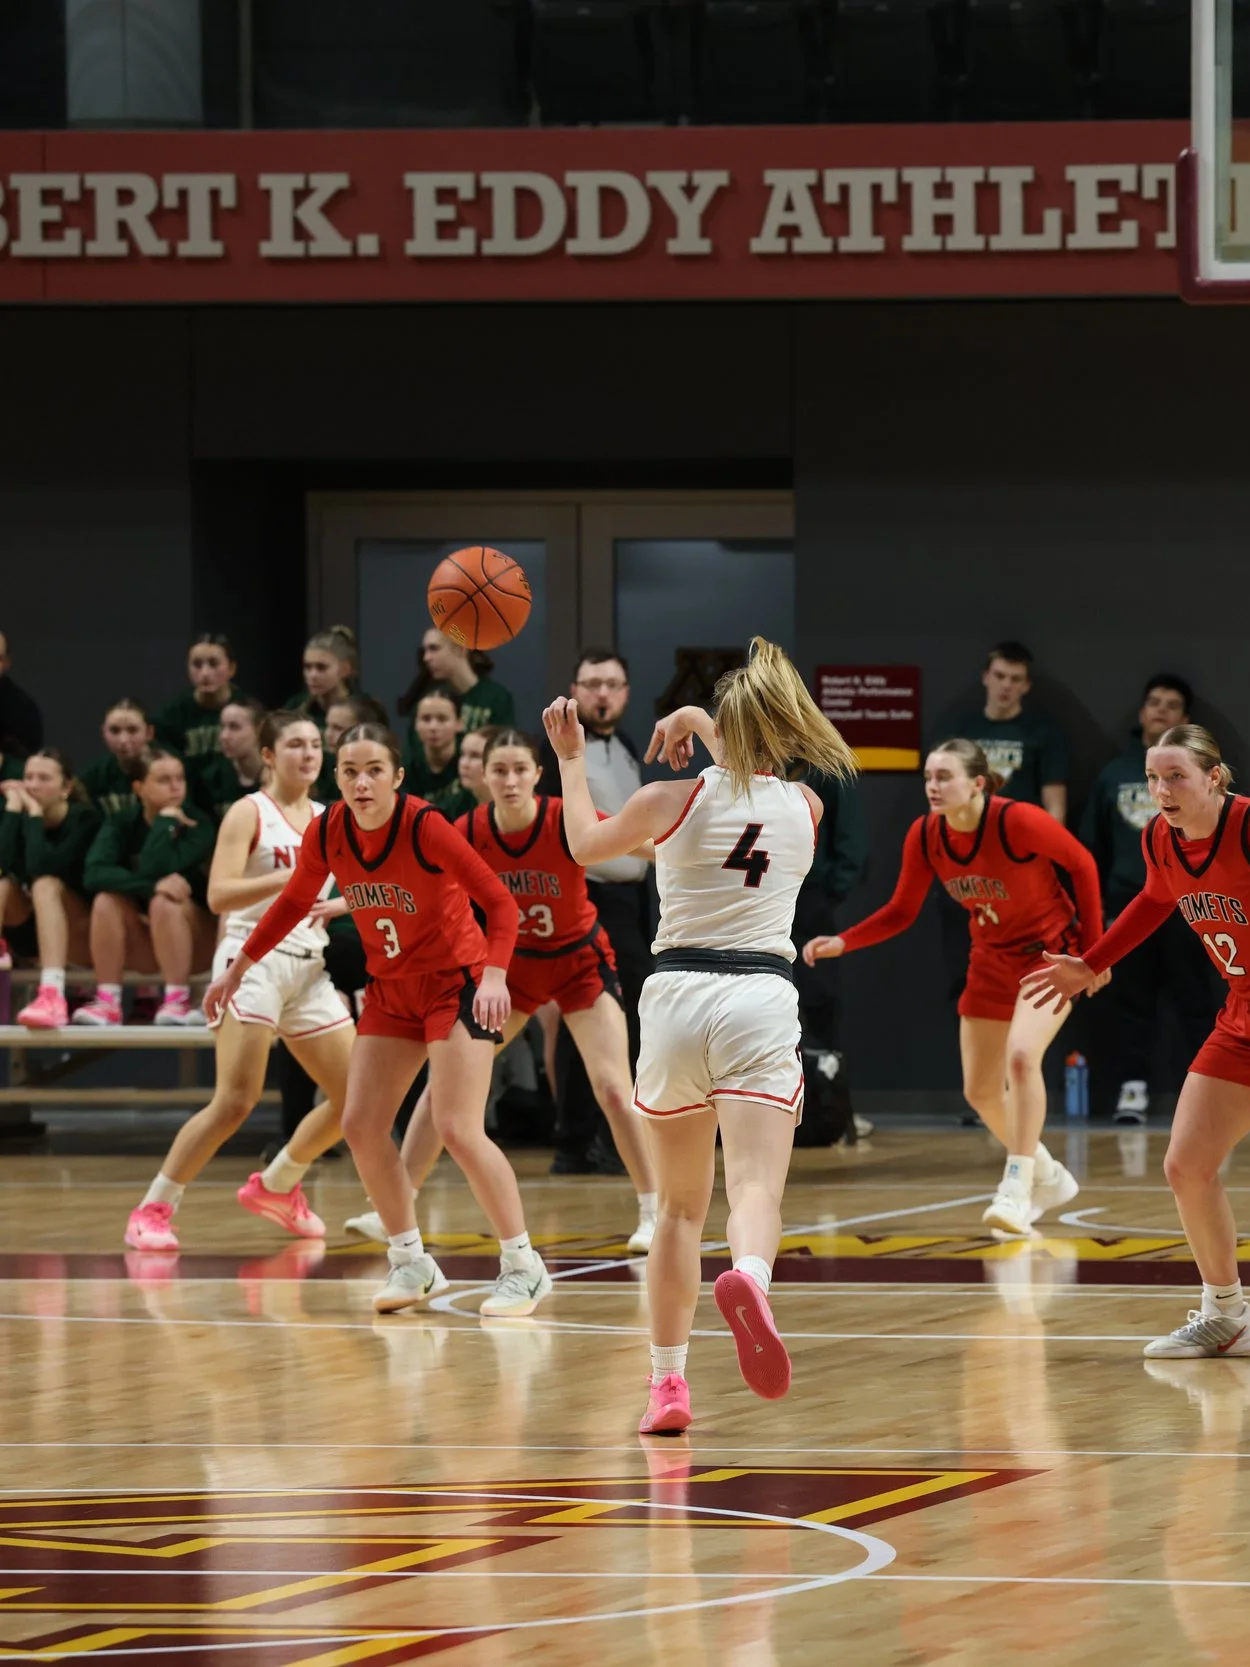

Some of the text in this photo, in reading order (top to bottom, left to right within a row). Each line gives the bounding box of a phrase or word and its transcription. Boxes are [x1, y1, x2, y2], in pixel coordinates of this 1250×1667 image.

[0, 173, 236, 257] ERT
[259, 173, 379, 257] K.
[404, 170, 730, 256] EDDY
[721, 823, 771, 888] 4
[344, 882, 417, 914] COMETS
[1177, 892, 1249, 925] OMETS
[375, 917, 401, 959] 3
[1202, 932, 1247, 976] 12
